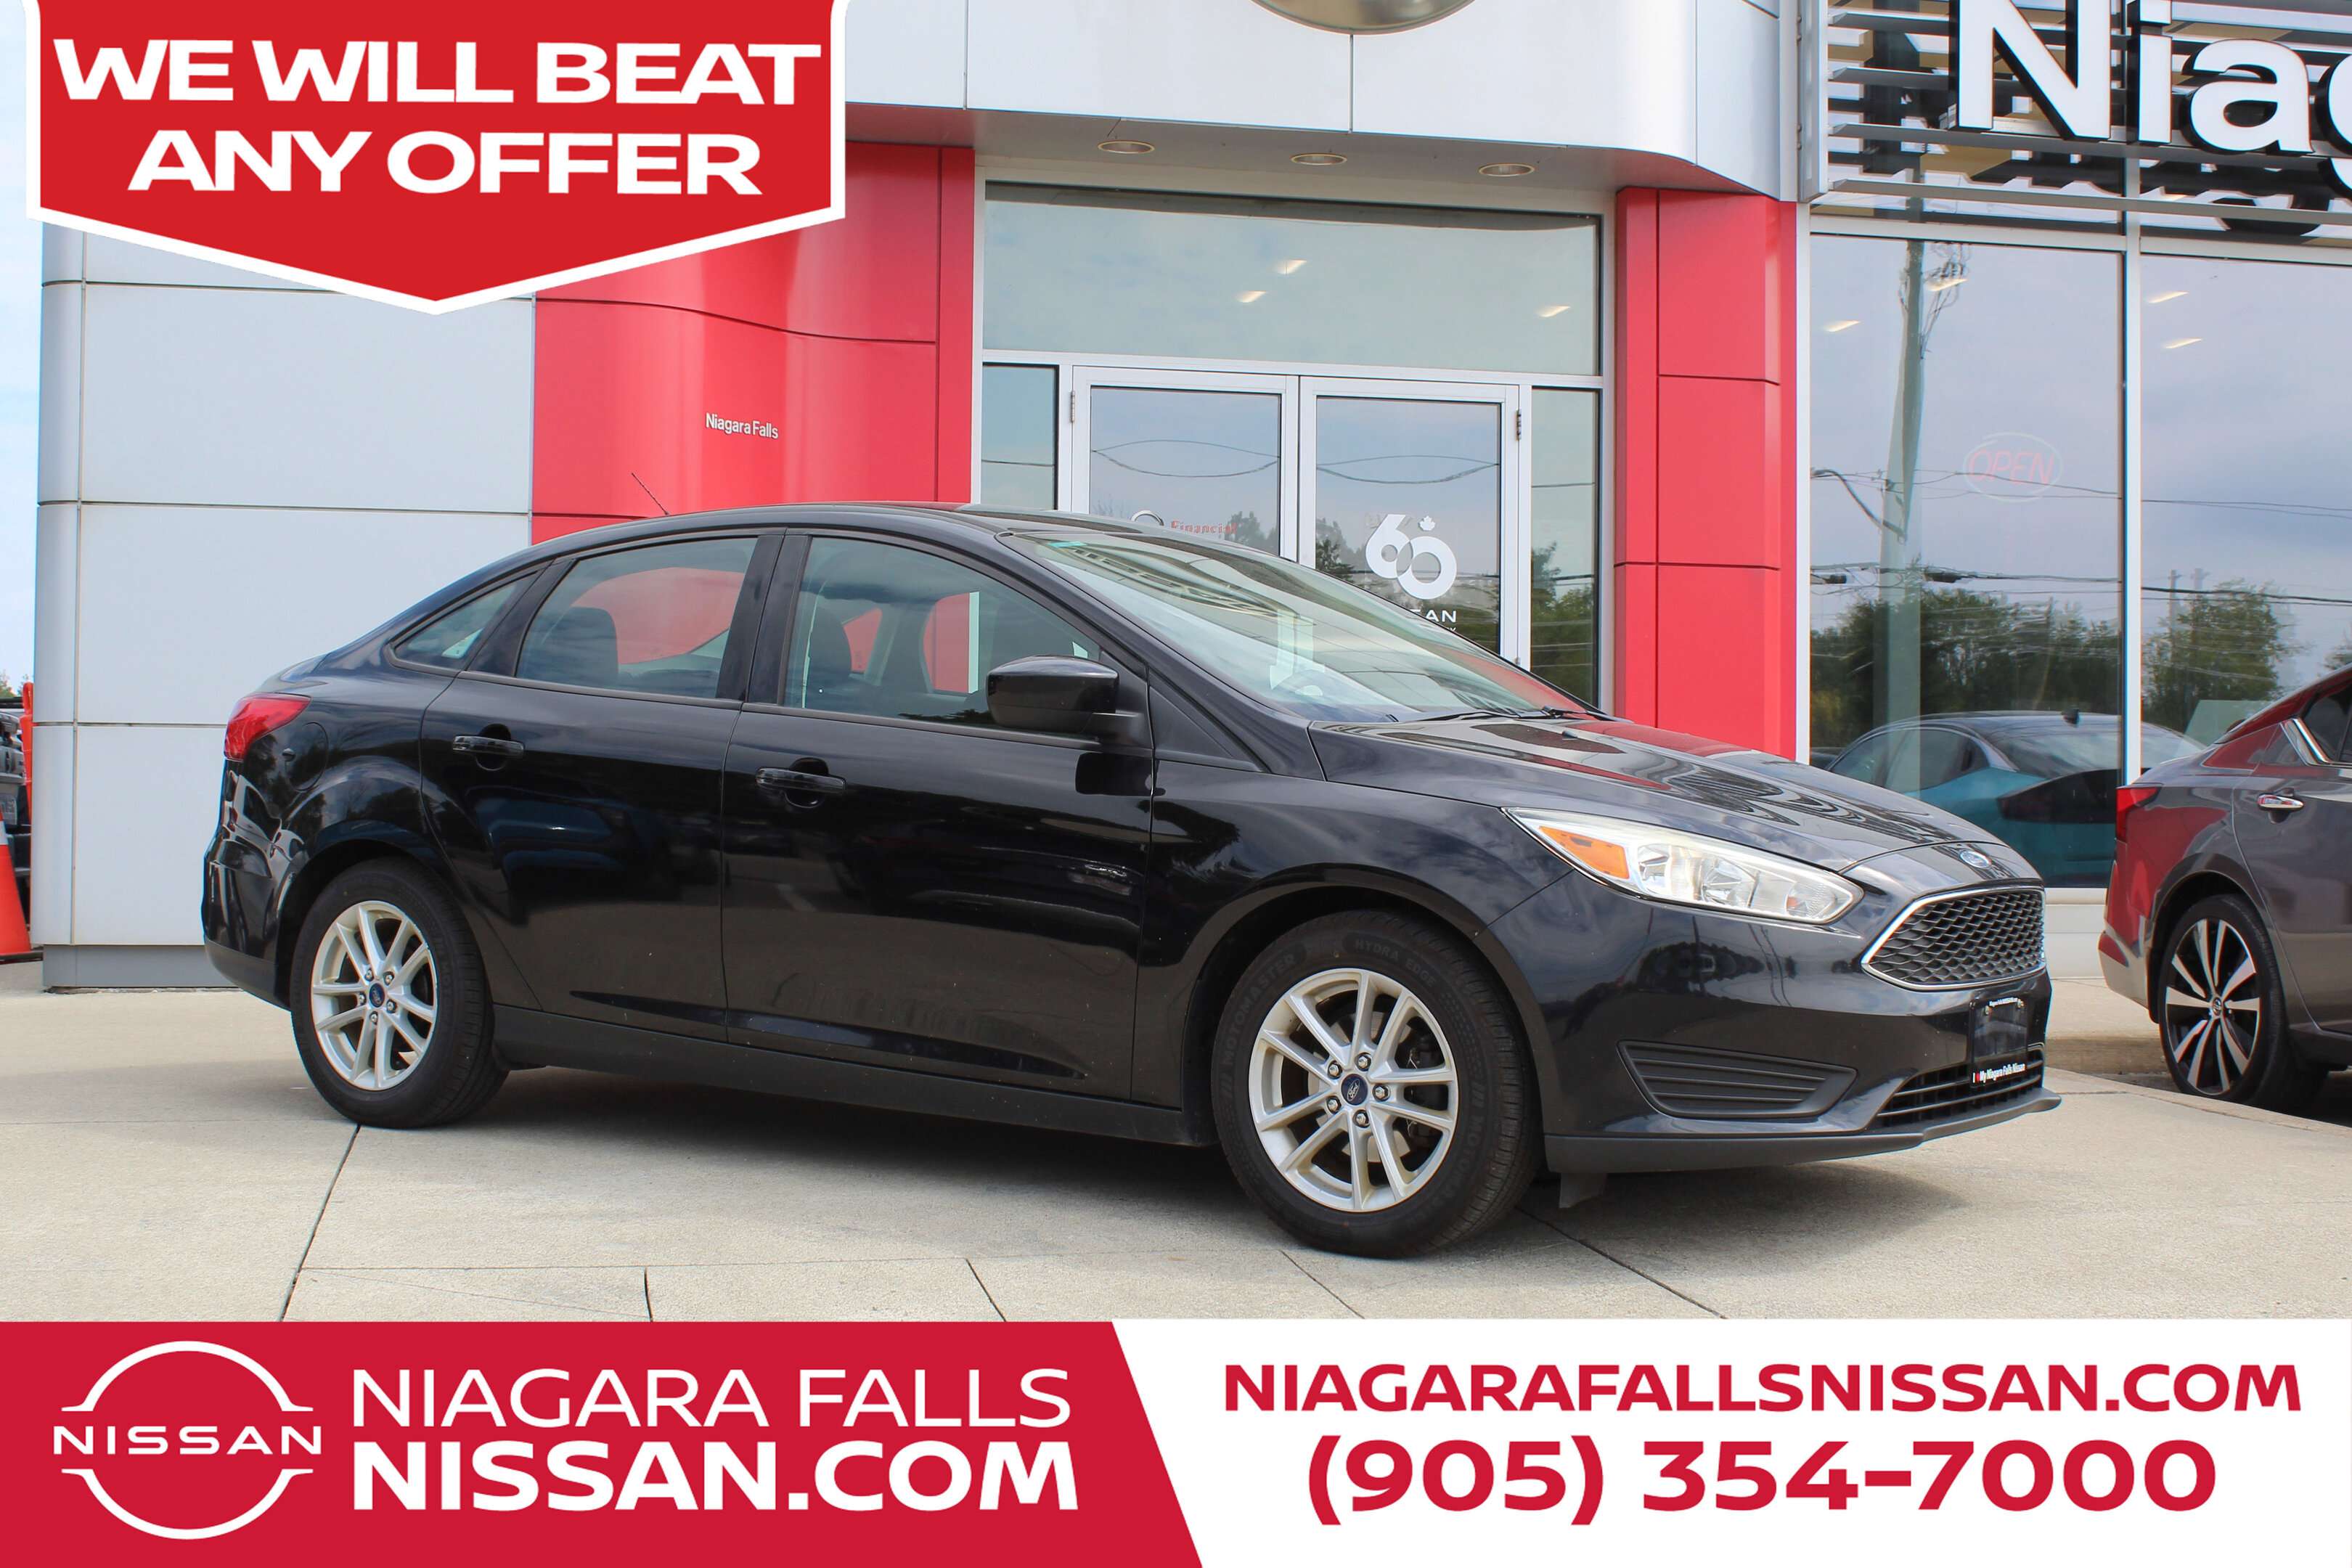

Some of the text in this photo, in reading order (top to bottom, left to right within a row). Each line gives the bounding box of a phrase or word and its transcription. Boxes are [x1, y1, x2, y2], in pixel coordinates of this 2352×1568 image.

[1958, 0, 2352, 189] Nia
[706, 412, 779, 439] Niagara Falls
[1968, 449, 2055, 485] OPEN
[1365, 513, 1457, 600] 60
